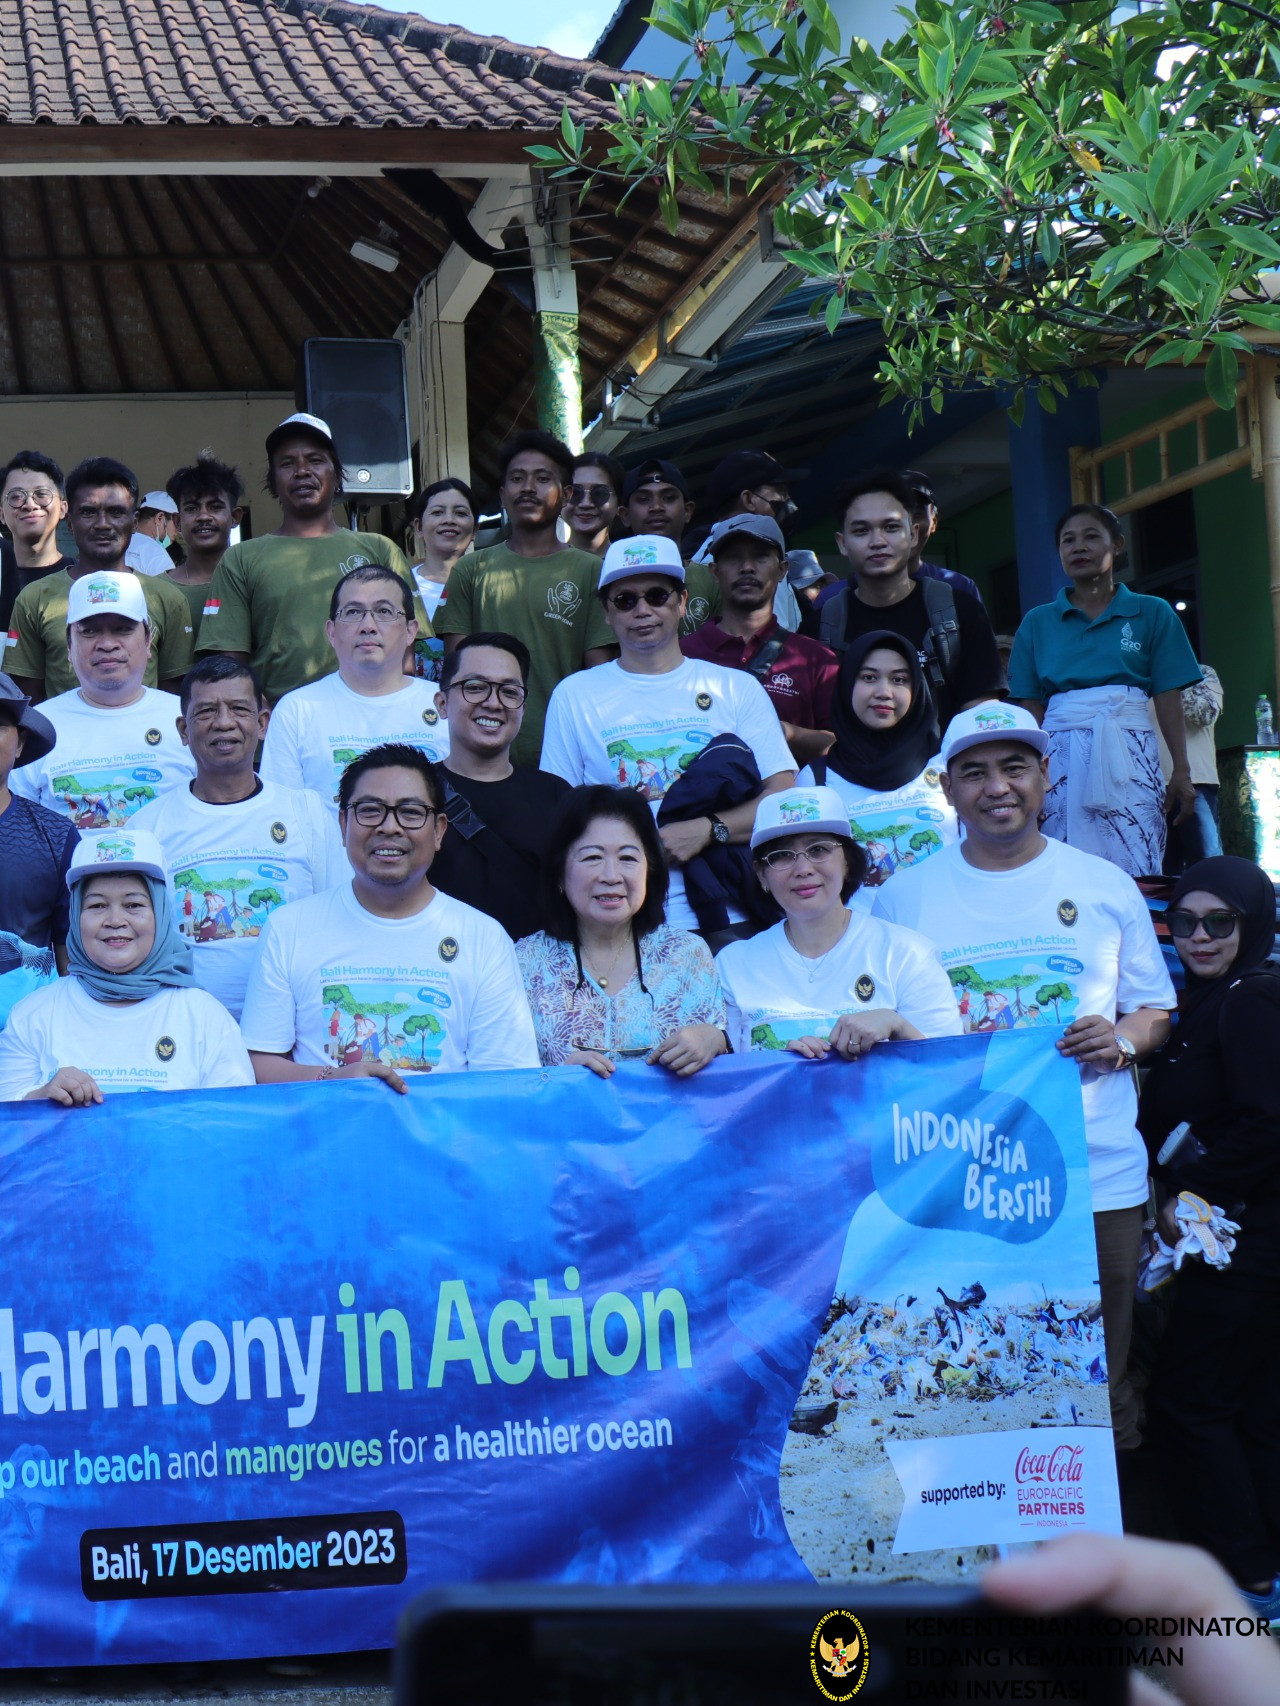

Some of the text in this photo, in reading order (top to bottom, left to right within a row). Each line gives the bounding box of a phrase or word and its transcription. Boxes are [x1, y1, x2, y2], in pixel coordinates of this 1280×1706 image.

[1120, 638, 1141, 651] G20
[601, 726, 619, 738] Bali
[619, 720, 664, 732] Harmony
[676, 716, 709, 724] Action
[328, 734, 346, 743] Bali
[347, 734, 390, 744] Harmony
[401, 731, 434, 740] Action
[68, 756, 113, 768] Harmony
[123, 751, 156, 761] Action
[848, 799, 893, 812] Harmony
[190, 850, 238, 861] Harmony
[251, 847, 286, 858] Action
[940, 949, 962, 961] Bali
[962, 940, 1019, 956] Harmony
[1020, 936, 1033, 946] in
[1034, 934, 1077, 945] Action
[320, 965, 449, 979] Bali Harmony in Action
[117, 1066, 127, 1075] in
[128, 1066, 168, 1078] Action
[336, 1282, 414, 1393] in
[427, 1266, 693, 1389] Action
[21, 1459, 70, 1489] our
[74, 1445, 161, 1485] beach
[167, 1441, 218, 1479] and
[225, 1435, 383, 1481] mangroves
[388, 1430, 427, 1465] for
[433, 1433, 450, 1462] a
[455, 1417, 581, 1460] healthier
[586, 1417, 673, 1453] ocean
[1015, 1444, 1086, 1484] Coca-Cola
[921, 1480, 1006, 1506] supported by:
[1017, 1487, 1084, 1501] EUROPACIFIC
[1018, 1502, 1085, 1516] PARTNERS
[1036, 1519, 1068, 1528] INDONESIA
[91, 1528, 396, 1585] Bali, 17 Desember 2023
